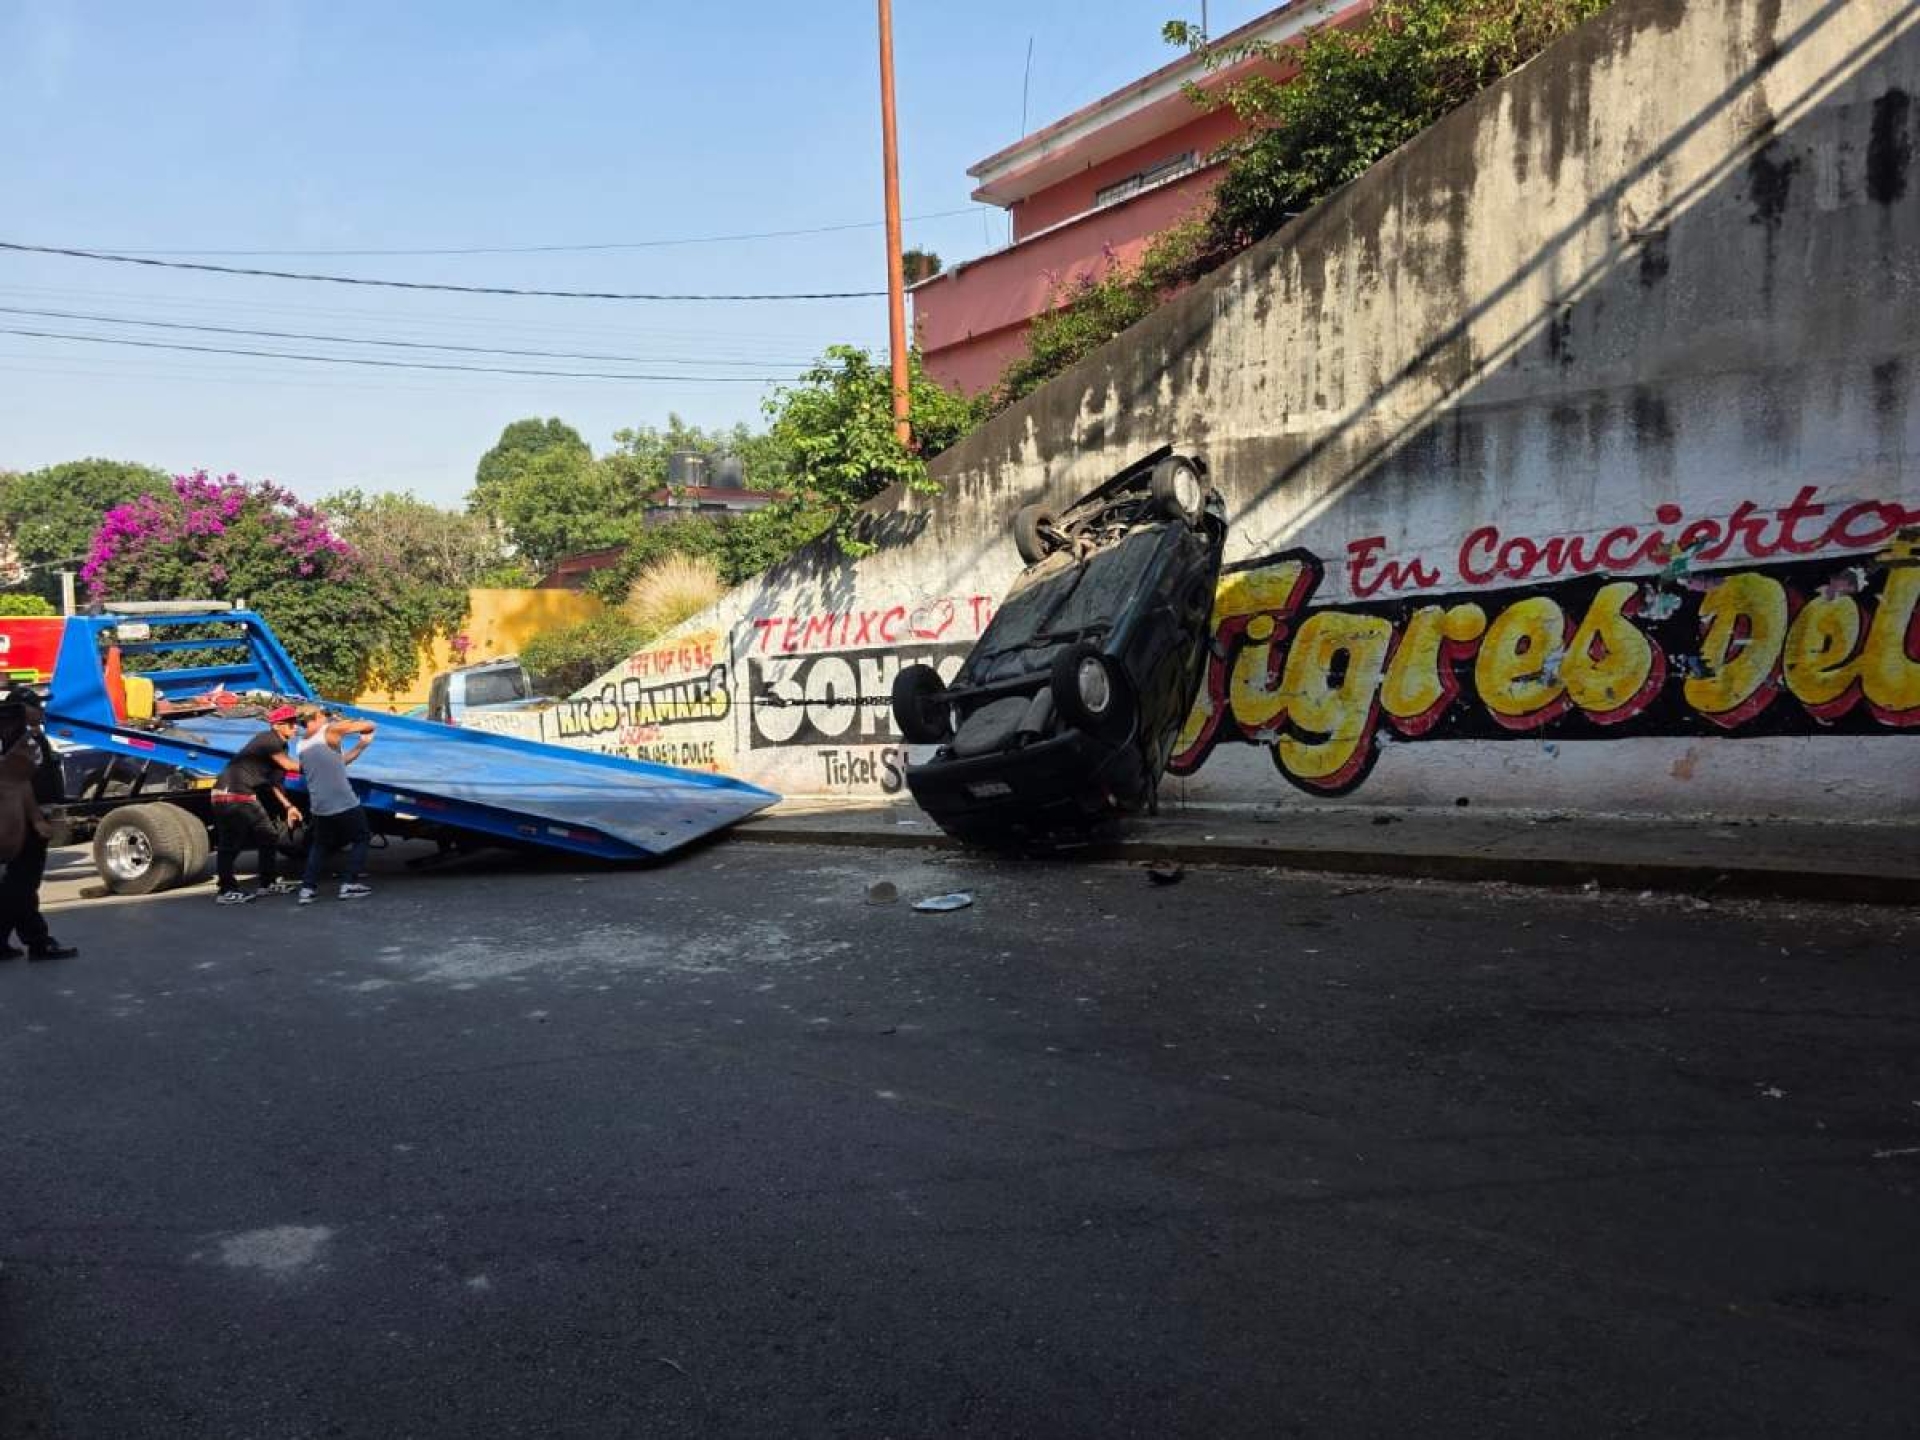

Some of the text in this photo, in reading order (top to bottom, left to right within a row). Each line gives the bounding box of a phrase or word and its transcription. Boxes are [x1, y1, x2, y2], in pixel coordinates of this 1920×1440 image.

[1347, 485, 1920, 598] En Concierto
[621, 664, 731, 727] TAMALES
[1166, 556, 1658, 788] Tigres
[818, 750, 877, 786] Ticket
